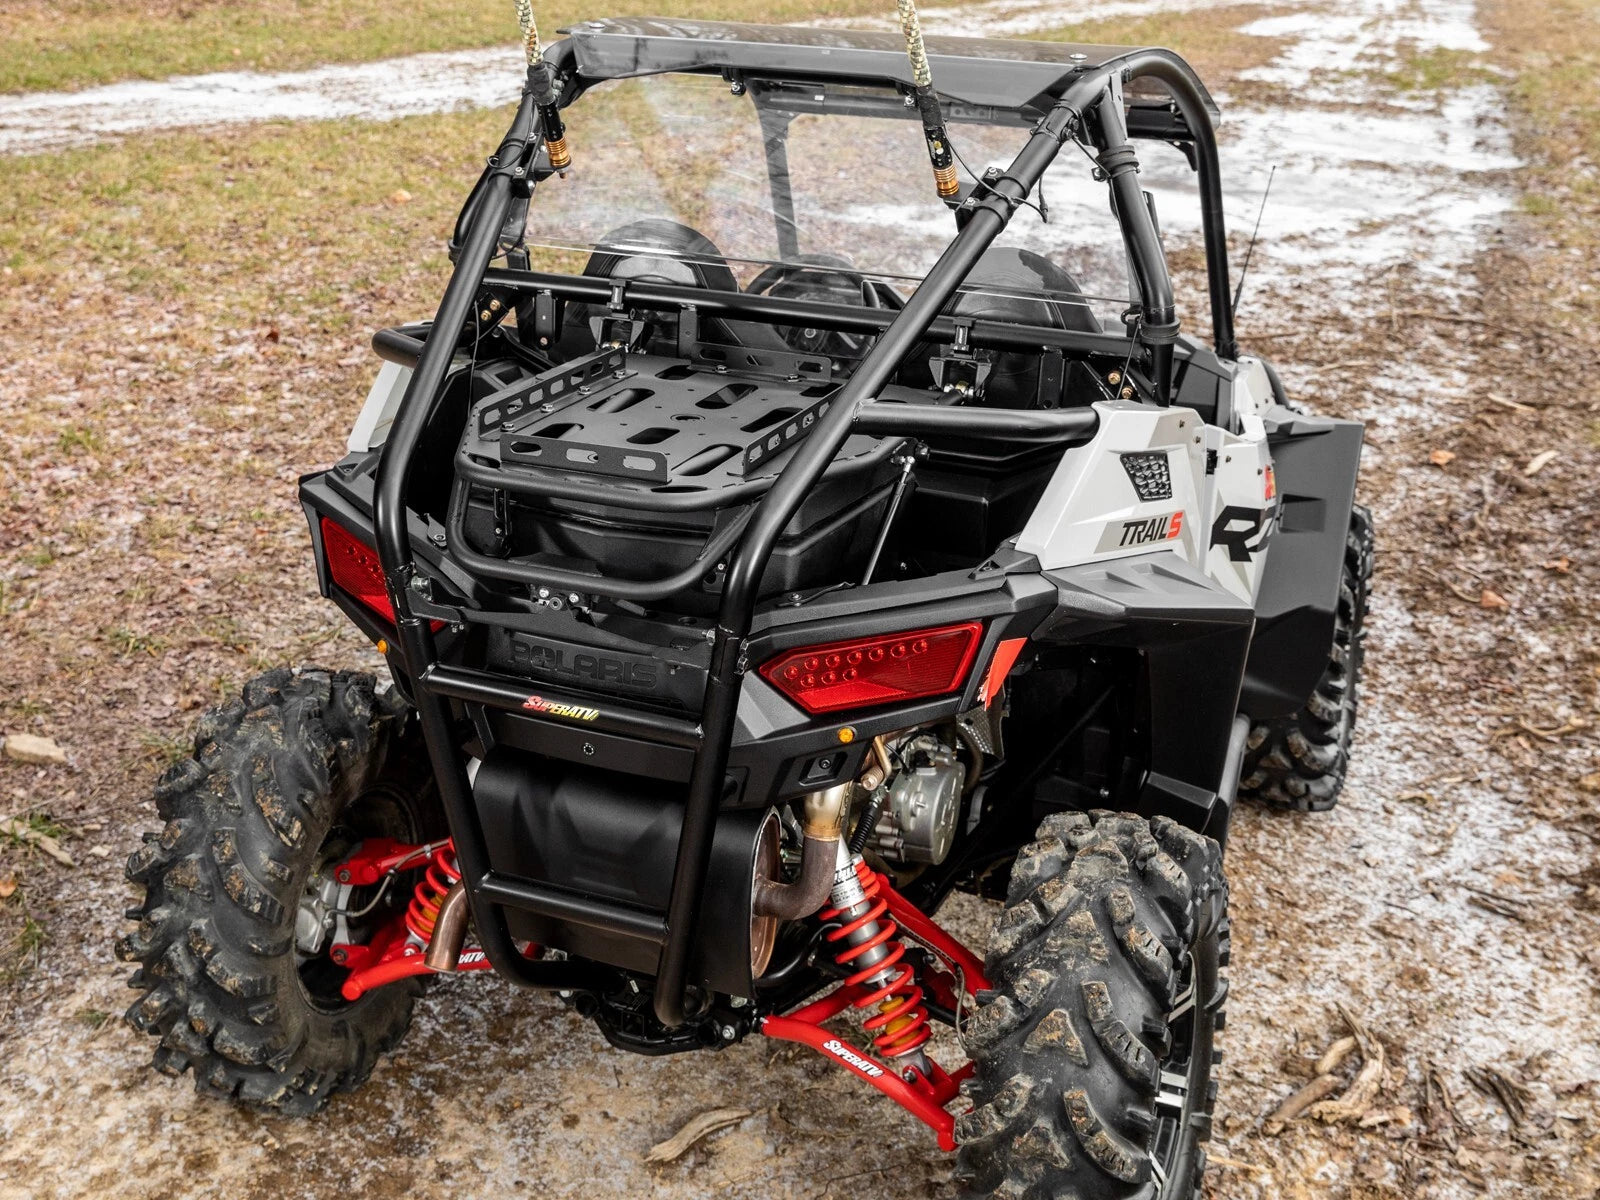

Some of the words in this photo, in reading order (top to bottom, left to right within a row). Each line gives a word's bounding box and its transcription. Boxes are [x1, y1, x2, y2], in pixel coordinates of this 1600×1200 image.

[509, 640, 657, 689] POLARIS
[523, 695, 600, 722] SUPERATV
[823, 1040, 885, 1079] SUPERATV
